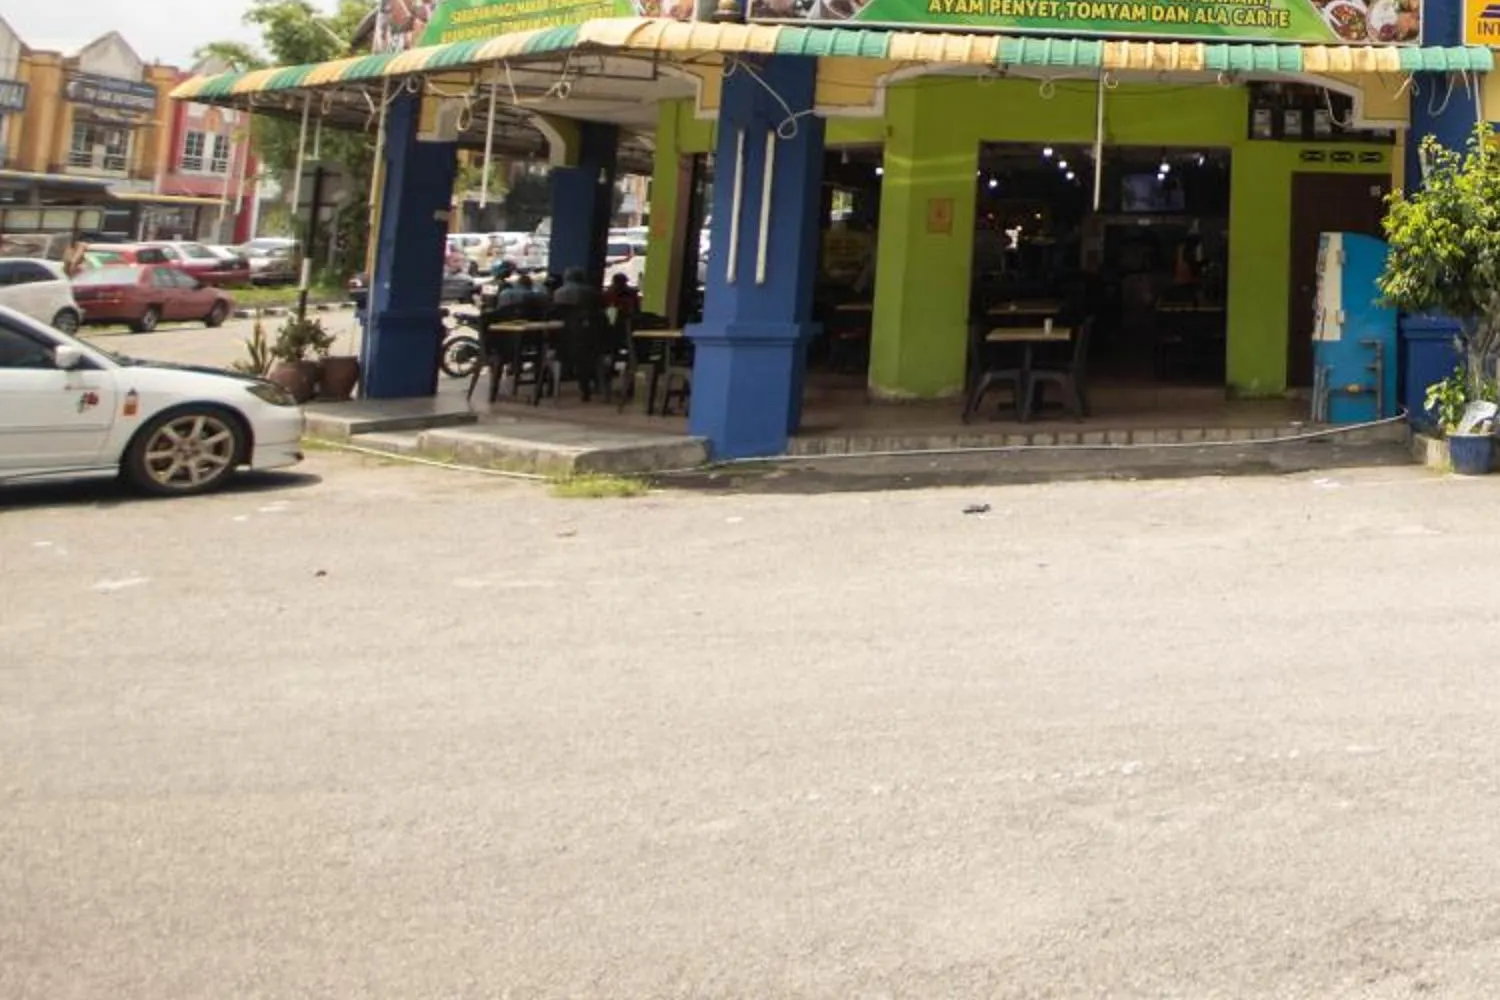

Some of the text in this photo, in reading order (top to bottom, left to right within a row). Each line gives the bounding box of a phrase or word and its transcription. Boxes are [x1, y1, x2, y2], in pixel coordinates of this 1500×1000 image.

[1151, 6, 1189, 22] DAN
[1195, 7, 1230, 25] ALA
[1233, 9, 1289, 27] CARTE
